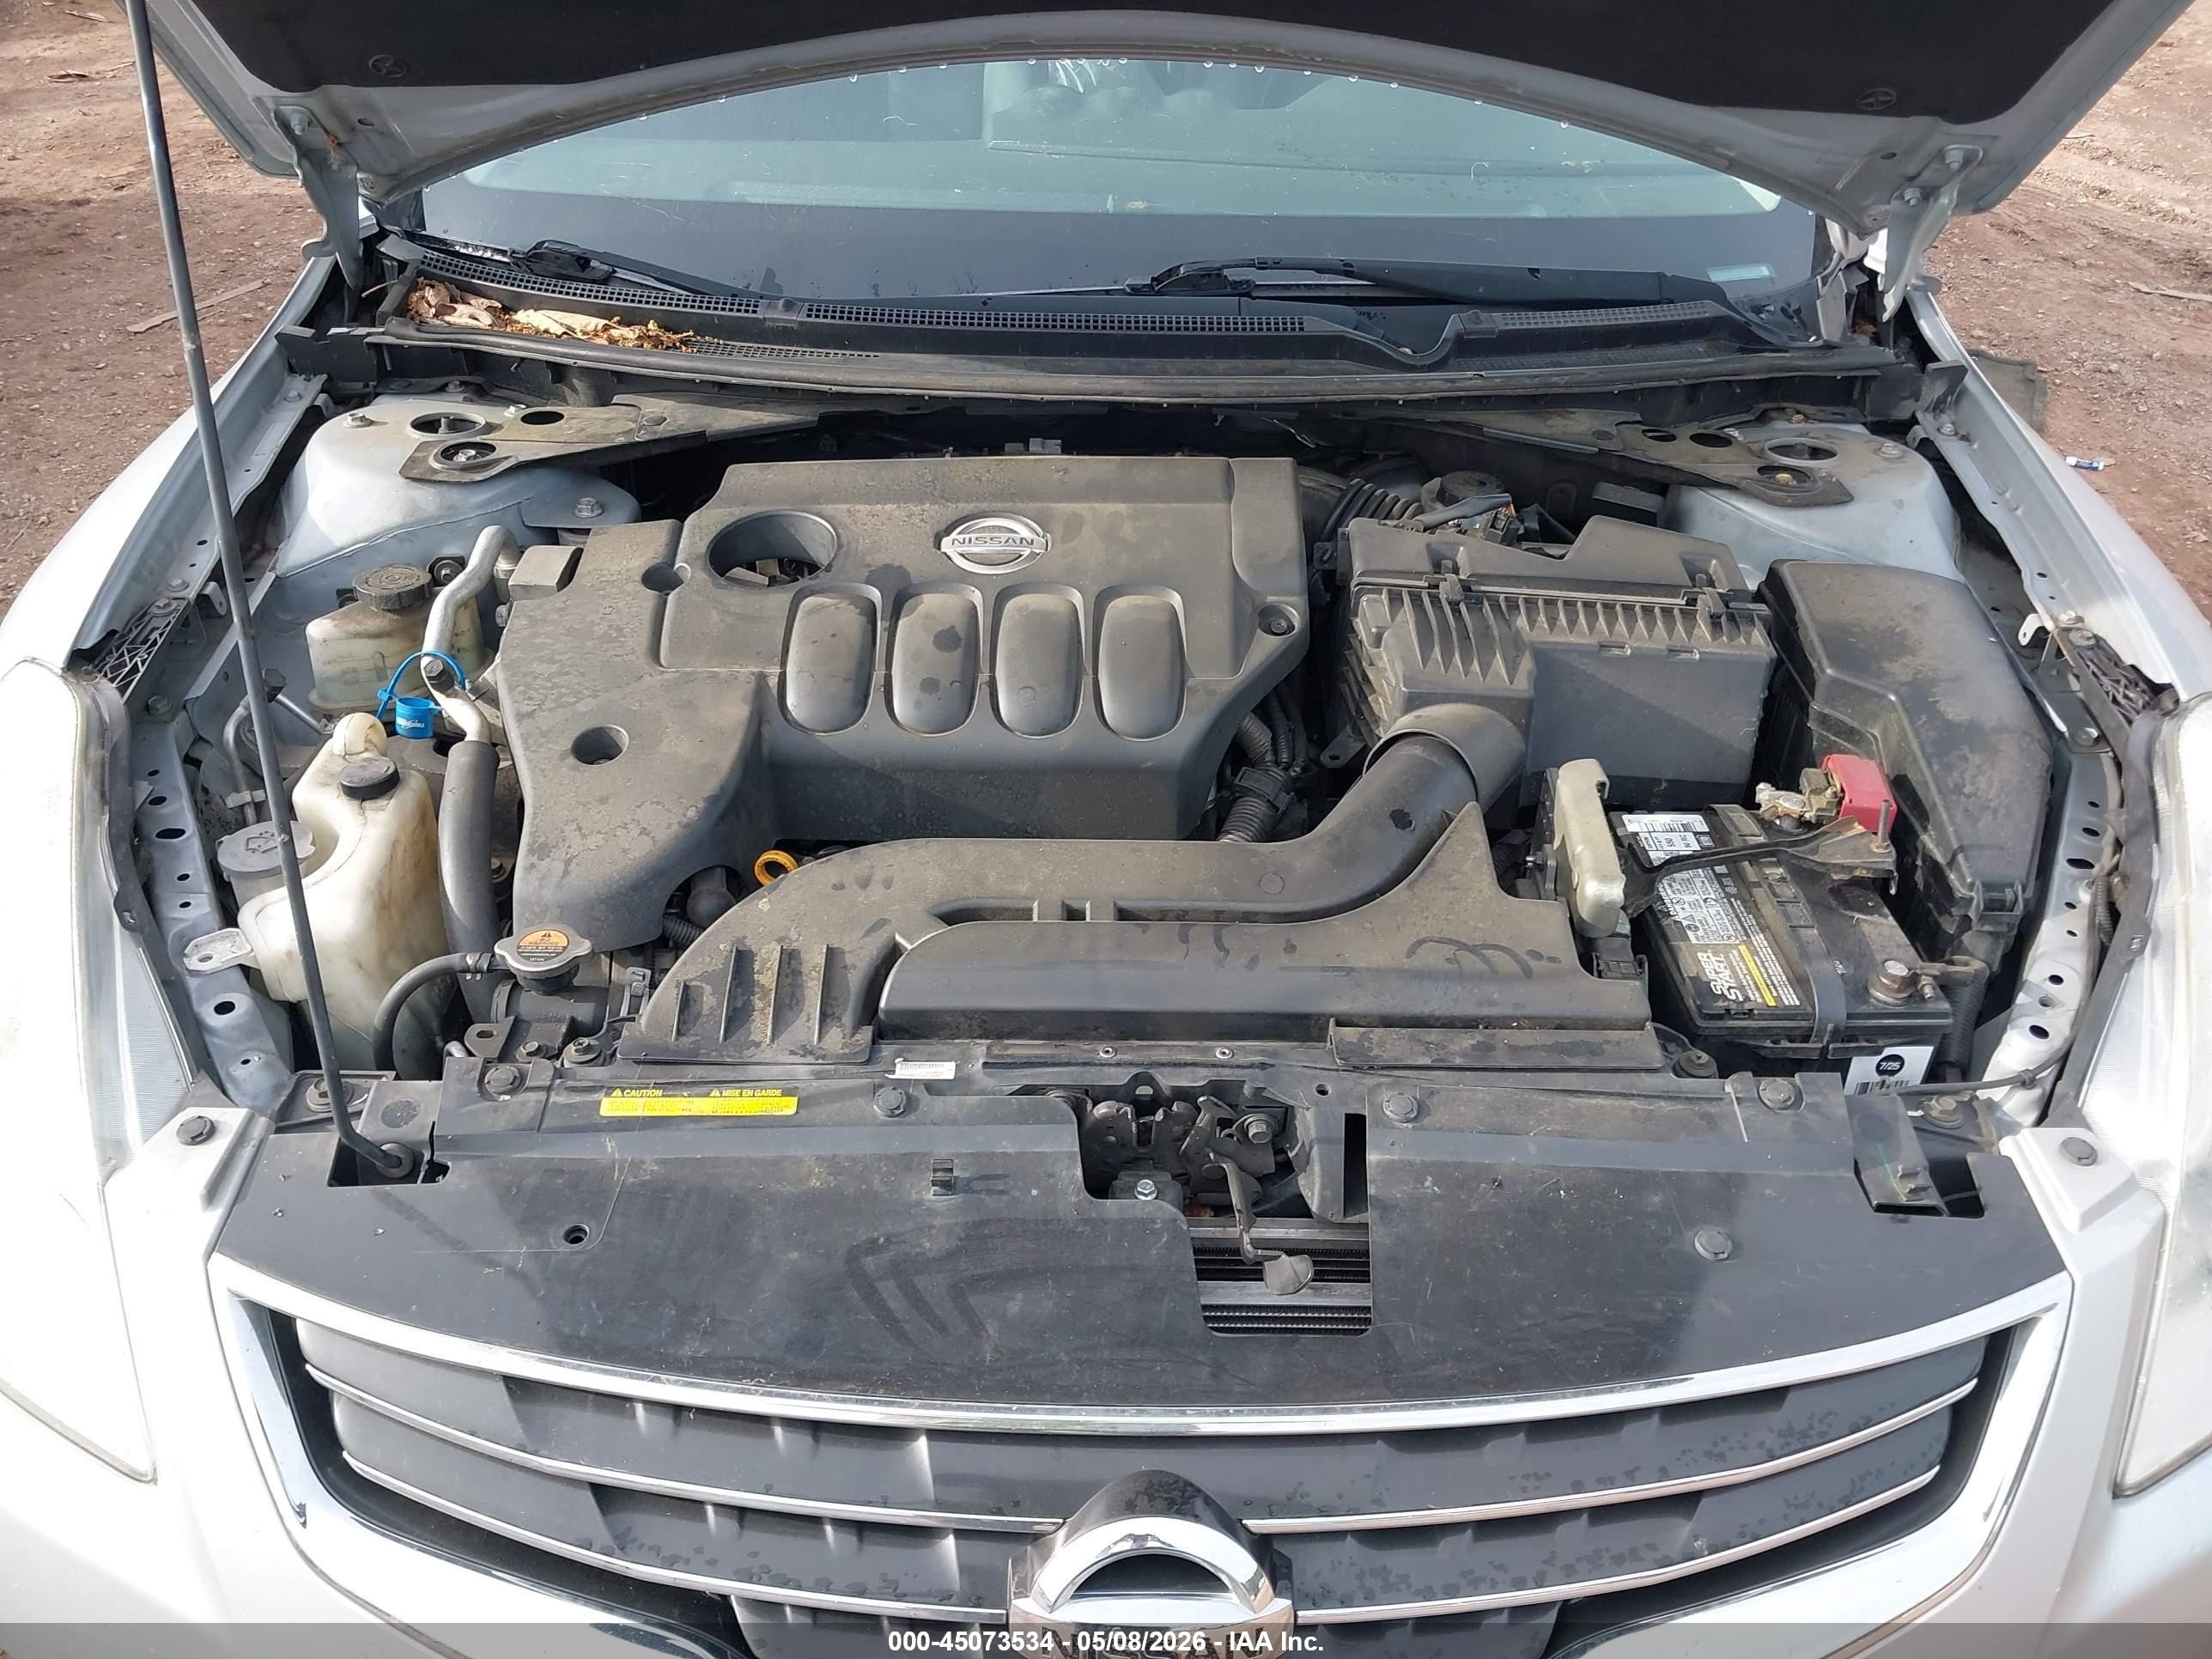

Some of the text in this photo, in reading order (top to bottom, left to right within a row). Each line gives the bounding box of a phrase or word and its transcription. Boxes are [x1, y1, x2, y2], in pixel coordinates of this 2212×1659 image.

[951, 537, 1034, 546] NISSAN
[1696, 952, 1724, 995] SUPER
[1711, 954, 1744, 1001] START
[1879, 1061, 1901, 1070] 7/25
[623, 1089, 663, 1097] CAUTION
